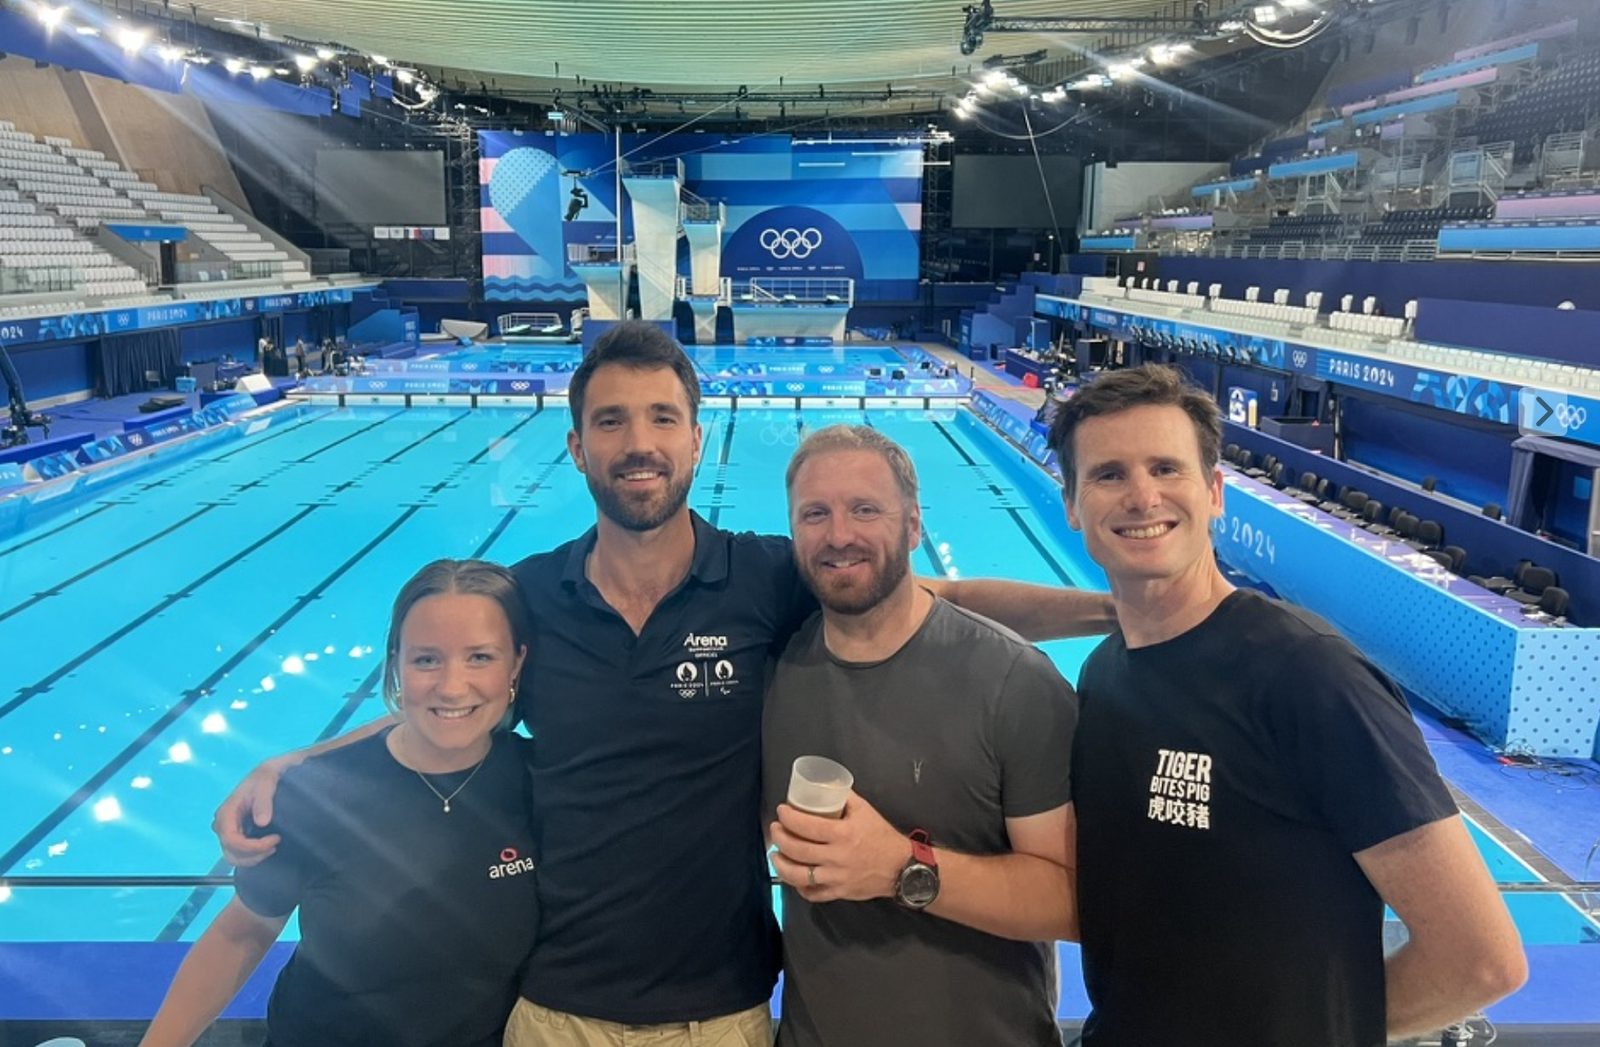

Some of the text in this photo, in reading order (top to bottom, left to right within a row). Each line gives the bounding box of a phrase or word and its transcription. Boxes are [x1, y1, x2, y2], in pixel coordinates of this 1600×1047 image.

[1328, 358, 1395, 387] PARIS 2024
[1232, 516, 1275, 565] 2024
[683, 632, 728, 647] Arena
[1156, 748, 1213, 784] TIGER
[1149, 775, 1211, 803] BITES PIG
[1147, 795, 1211, 830] 虎咬豬
[488, 857, 535, 880] arena
